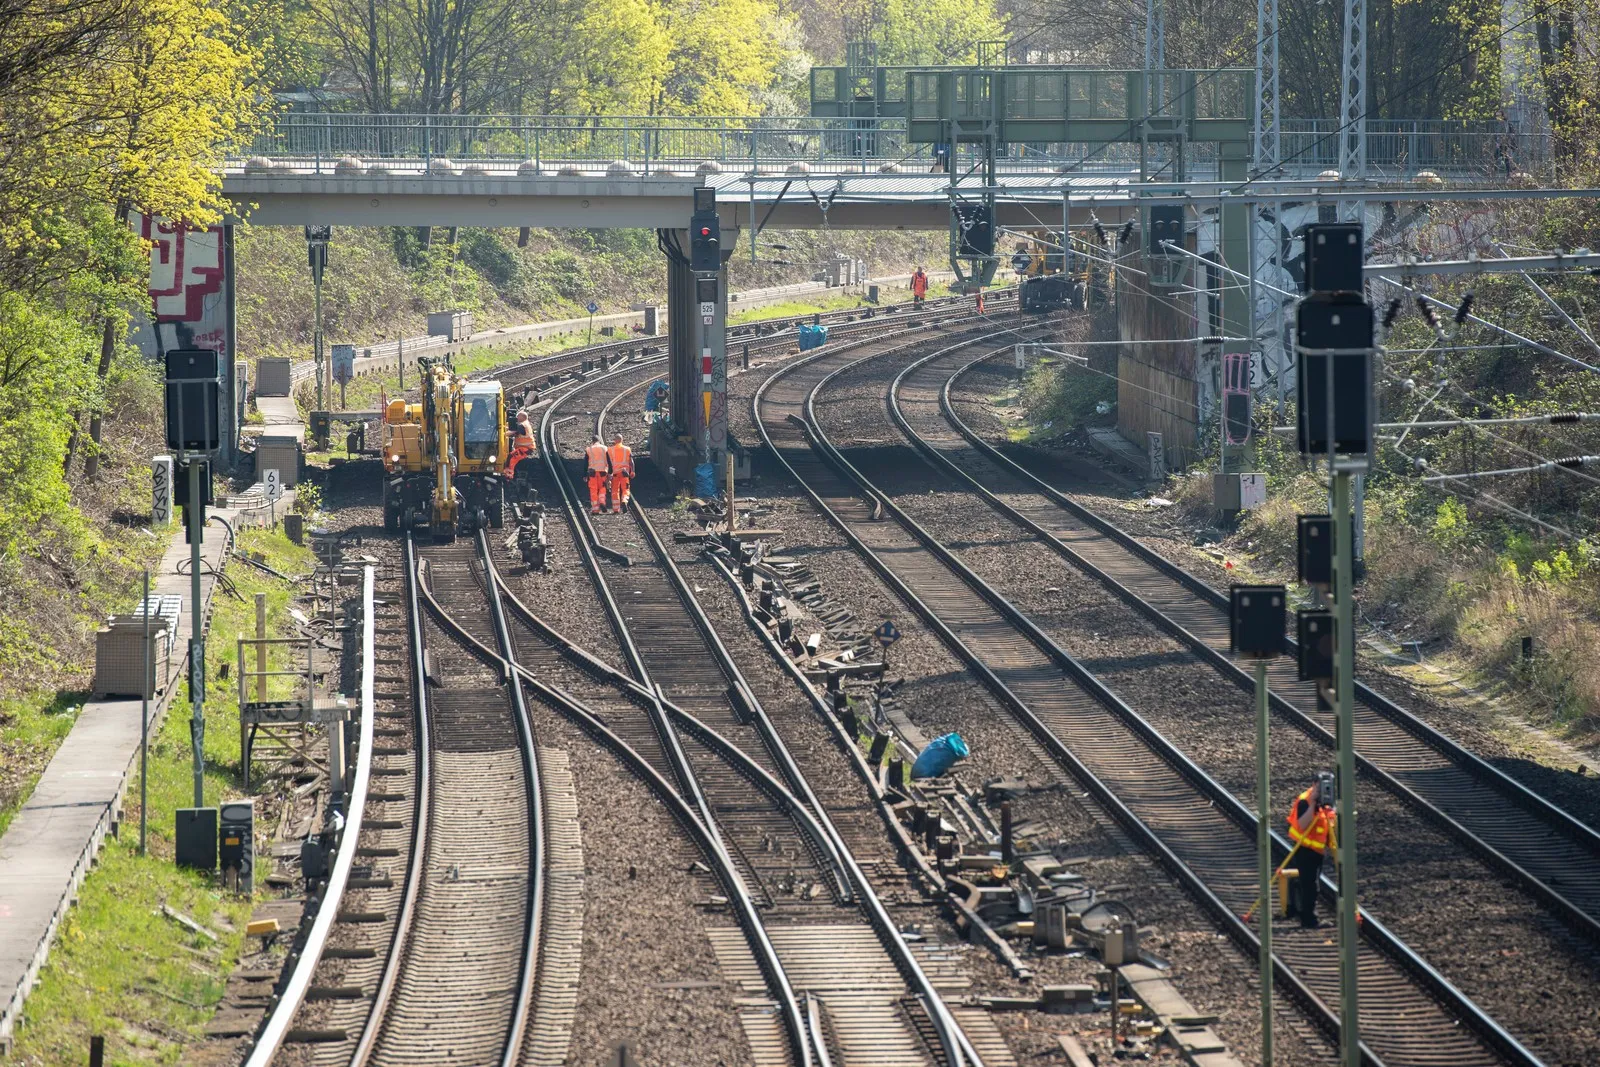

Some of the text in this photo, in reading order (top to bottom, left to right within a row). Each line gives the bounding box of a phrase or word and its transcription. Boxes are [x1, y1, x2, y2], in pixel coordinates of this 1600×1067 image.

[702, 304, 713, 313] 525
[267, 471, 275, 483] 6
[268, 483, 276, 495] 2
